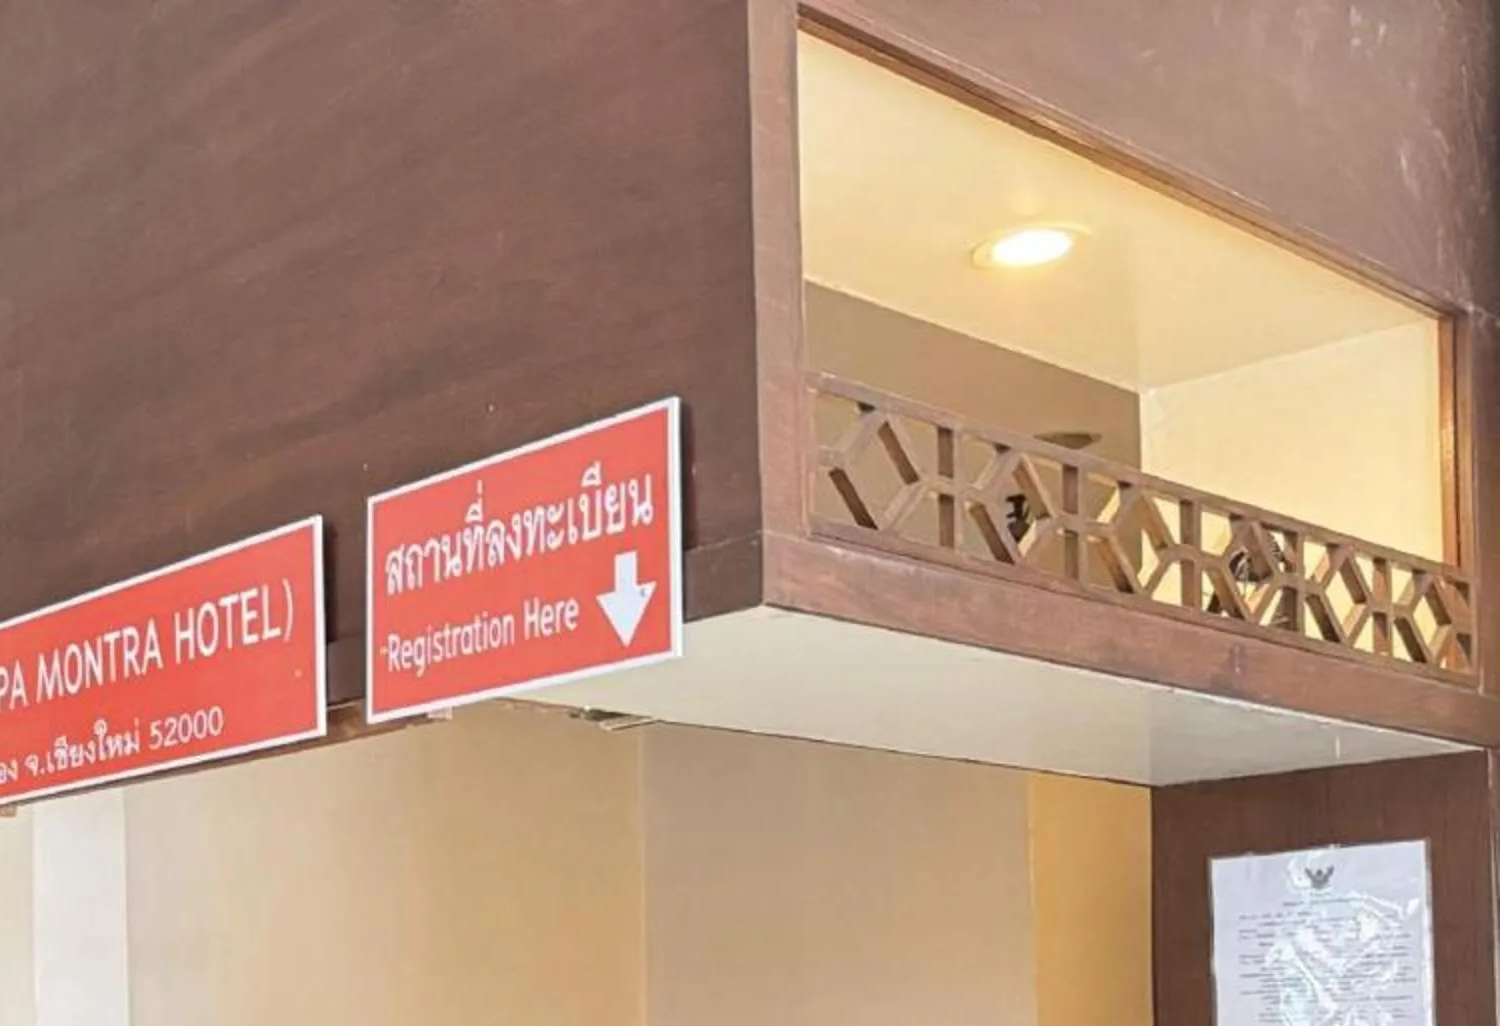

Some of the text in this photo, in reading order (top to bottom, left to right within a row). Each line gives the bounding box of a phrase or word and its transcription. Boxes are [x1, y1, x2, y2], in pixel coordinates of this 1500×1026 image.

[385, 459, 654, 596] สถานที่ลงทะเบียน
[35, 618, 164, 704] MONTRA
[173, 577, 294, 665] HOTEL)
[387, 598, 580, 678] Registration Here
[24, 718, 141, 777] จ.เชียงใหม่
[148, 704, 225, 751] 52000
